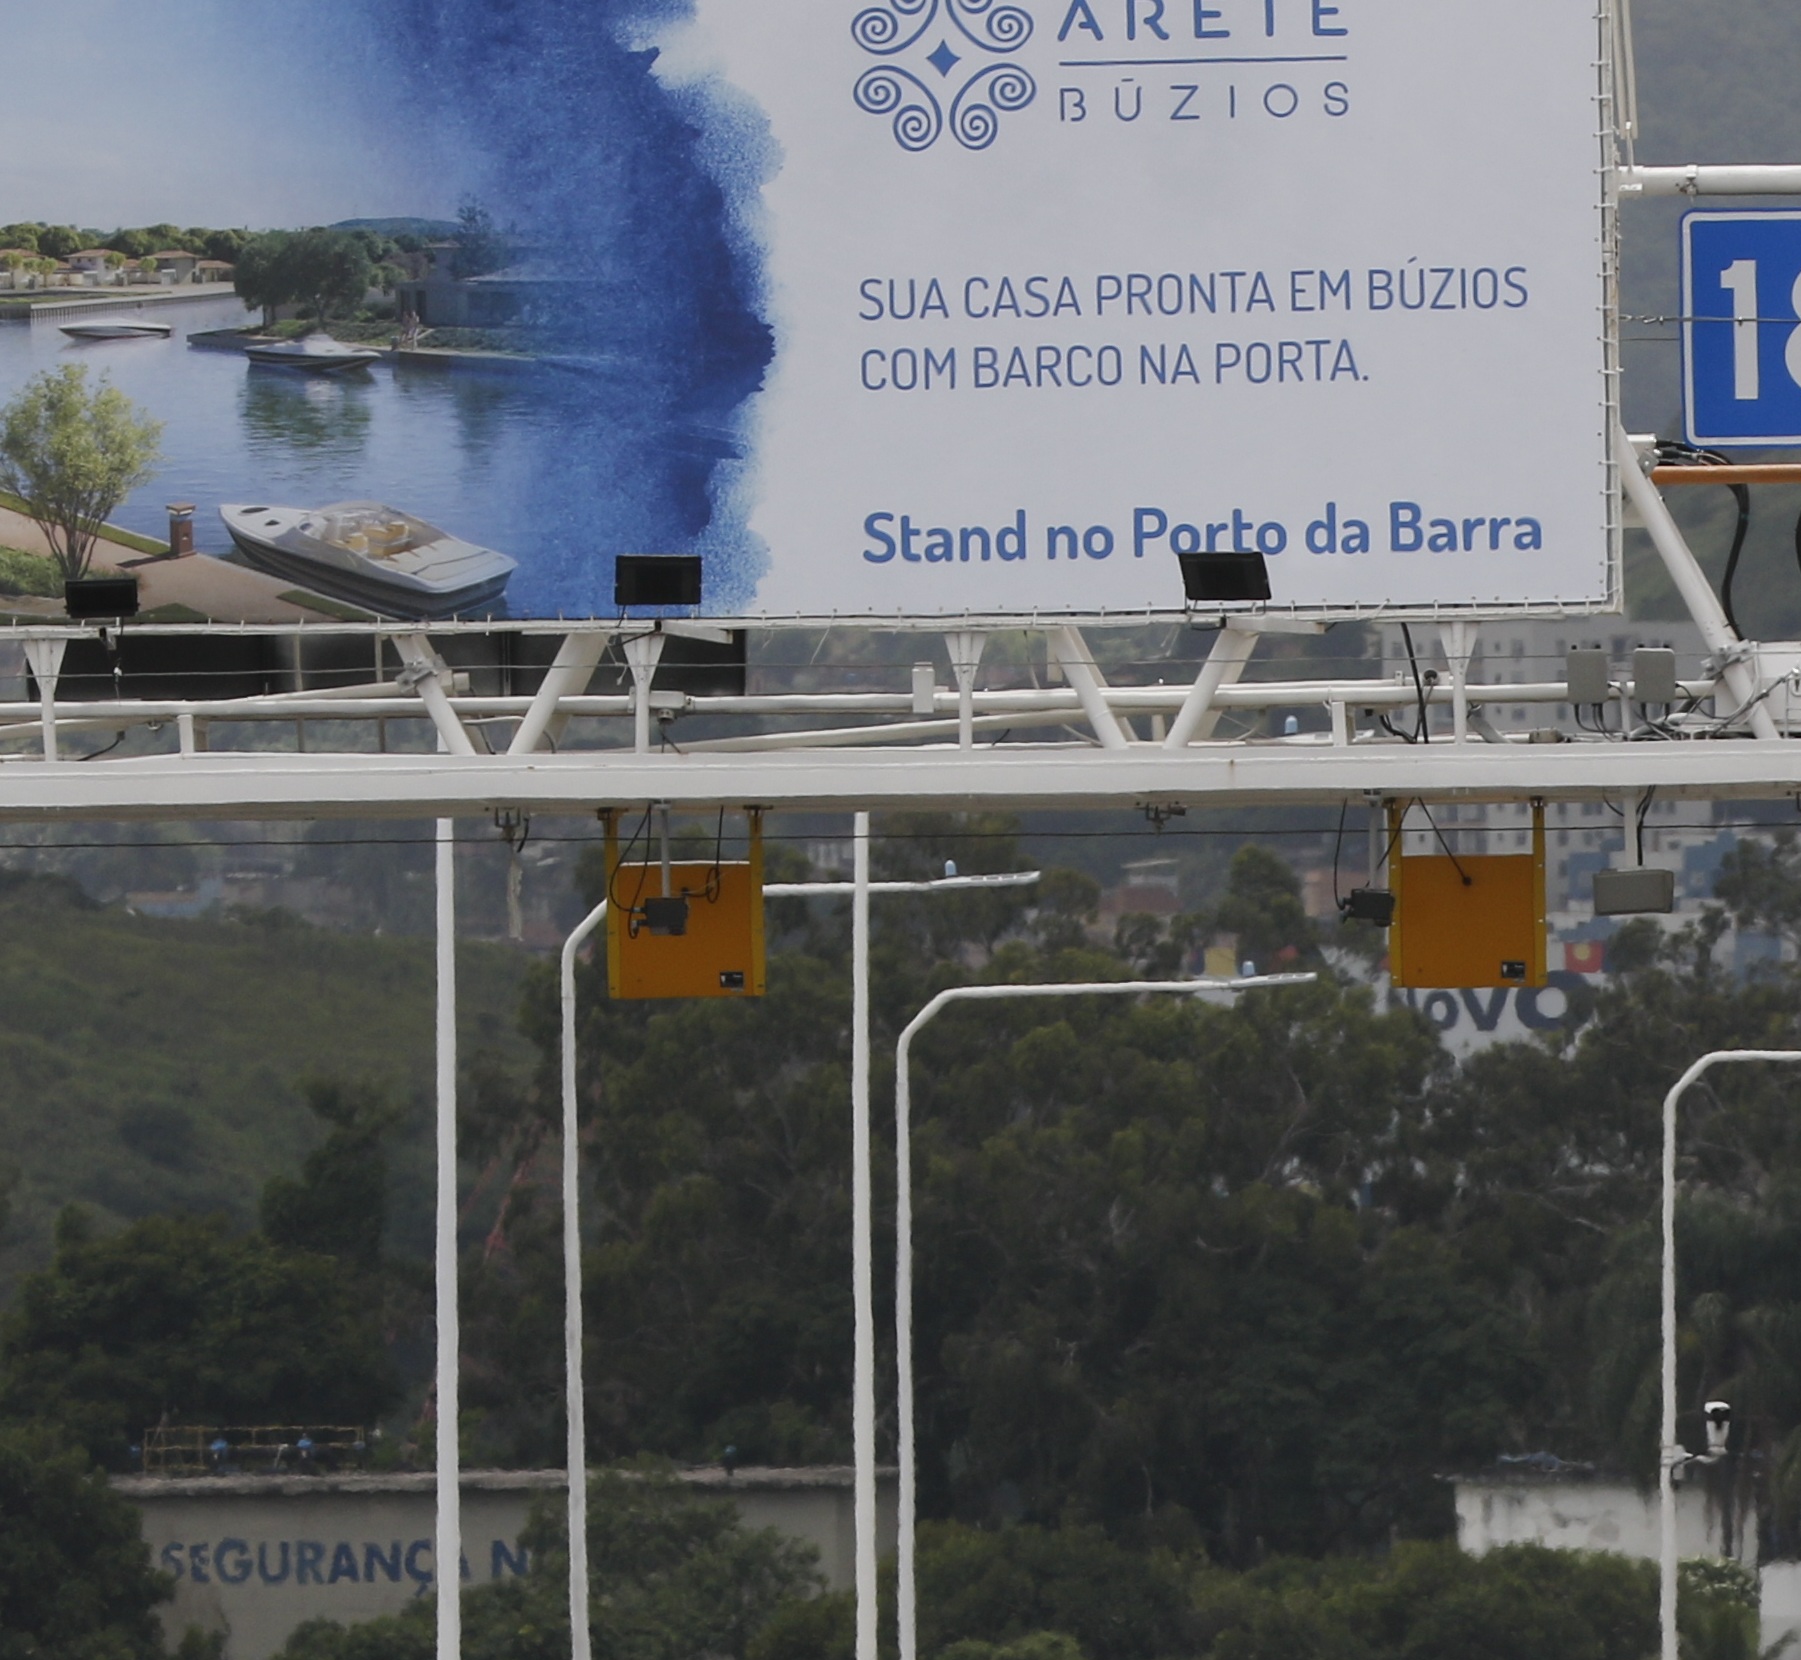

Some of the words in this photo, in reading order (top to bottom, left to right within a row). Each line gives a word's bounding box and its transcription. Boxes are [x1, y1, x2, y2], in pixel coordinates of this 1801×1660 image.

[1059, 78, 1350, 121] BÚZIOS
[858, 278, 949, 321] SUA
[962, 275, 1082, 319] CASA
[1096, 271, 1275, 317] PRONTA
[1290, 269, 1351, 312] EM
[1367, 257, 1529, 311] BÚZIOS
[860, 347, 956, 391] COM
[973, 344, 1123, 389] BARCO
[1139, 343, 1200, 385] NA
[1215, 338, 1370, 384] PORTA.
[861, 509, 1027, 564] Stand
[1046, 522, 1115, 561] no
[1132, 507, 1288, 558] Porto
[1304, 502, 1370, 554] da
[1389, 501, 1542, 553] Barra
[160, 1535, 470, 1596] SEGURANÇ
